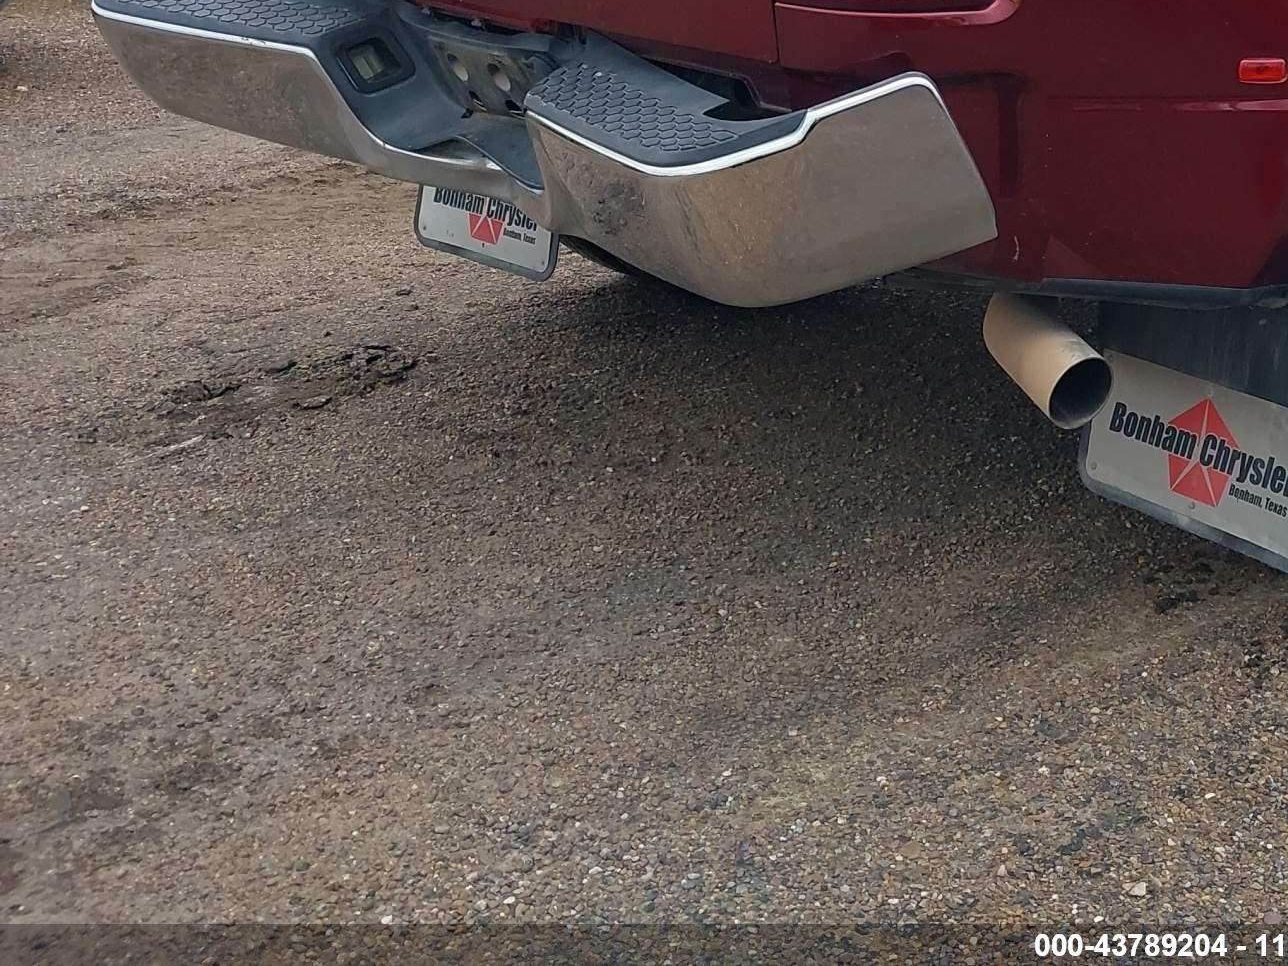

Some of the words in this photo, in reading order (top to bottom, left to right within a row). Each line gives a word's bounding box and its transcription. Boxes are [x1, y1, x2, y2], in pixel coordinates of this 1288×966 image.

[1109, 401, 1199, 461] Bonham
[1228, 484, 1263, 510] Bonham,
[1264, 497, 1288, 518] Texas
